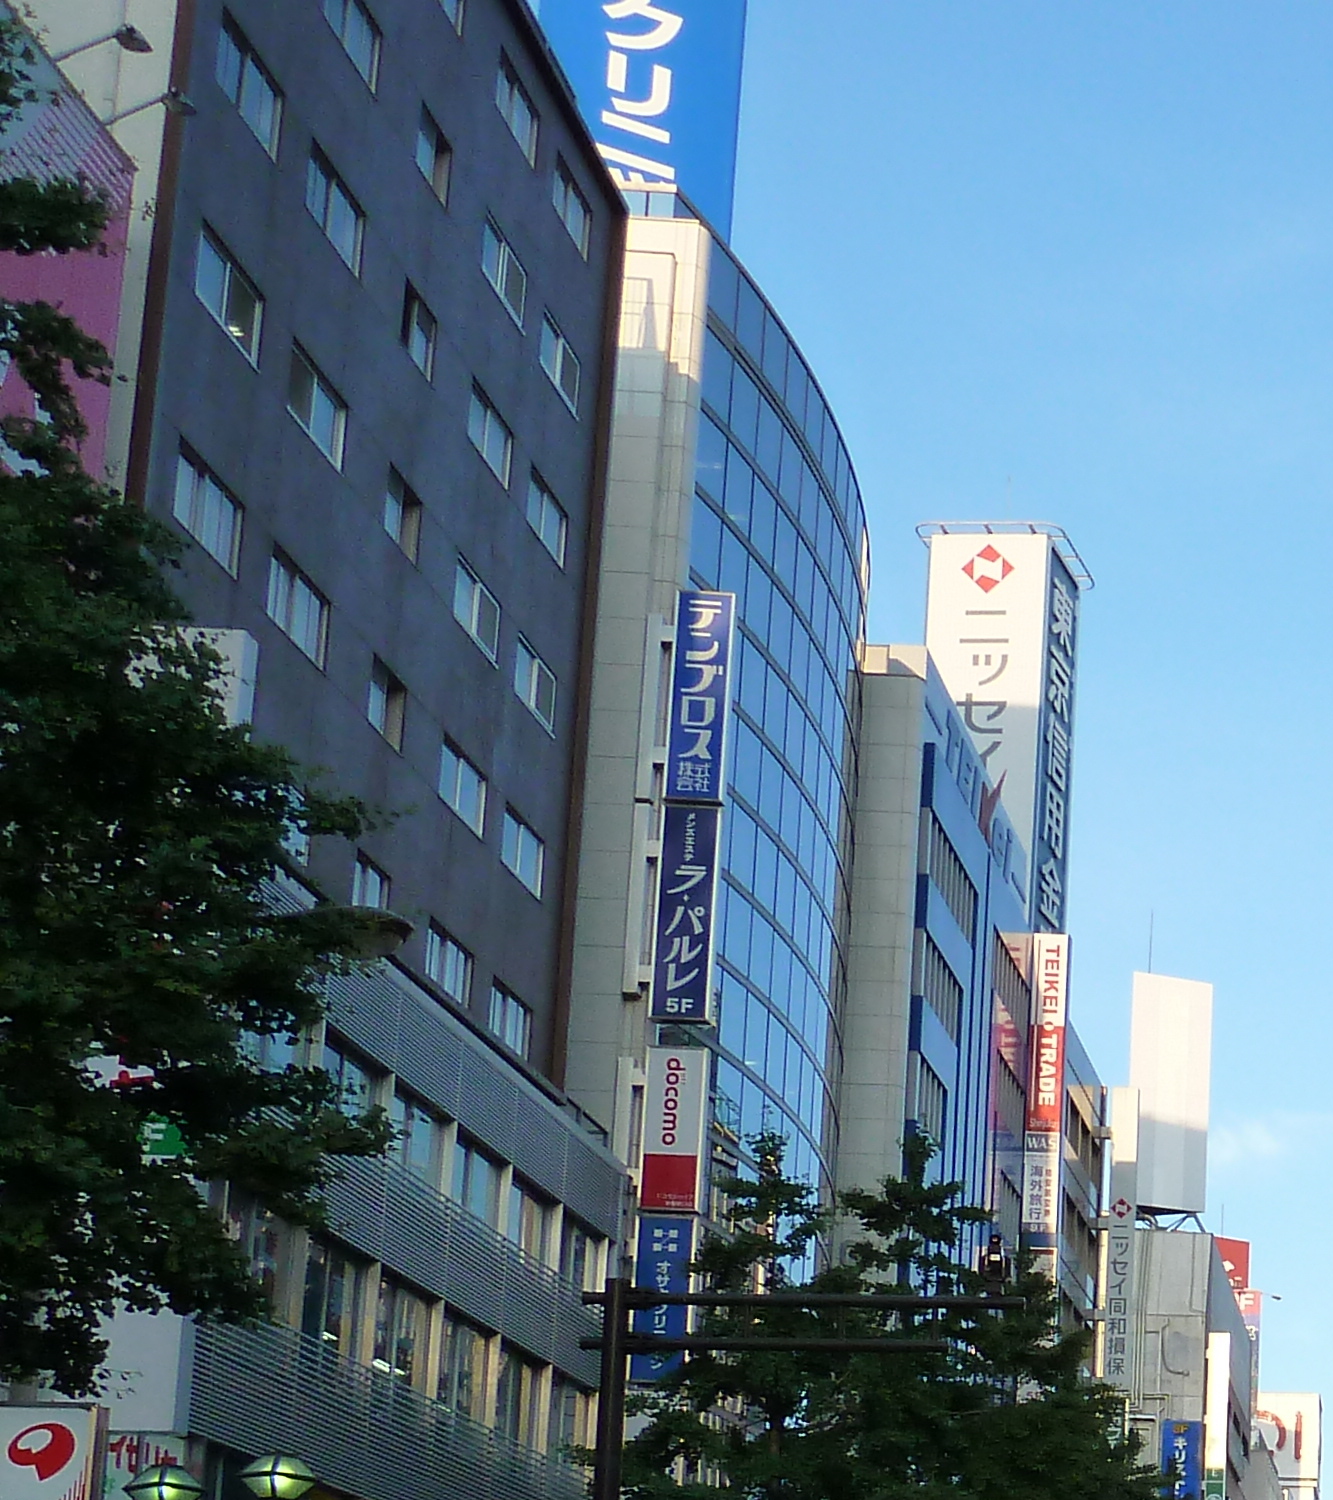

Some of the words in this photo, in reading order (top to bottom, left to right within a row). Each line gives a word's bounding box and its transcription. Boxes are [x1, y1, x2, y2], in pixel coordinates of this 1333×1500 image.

[596, 0, 684, 183] クリニ
[678, 600, 724, 760] テンブロス
[1037, 578, 1072, 932] 東京信用金
[665, 998, 694, 1013] 5F
[1043, 944, 1060, 1014] TEIKEI
[662, 1057, 686, 1146] docomo
[1038, 1034, 1058, 1106] TRADE
